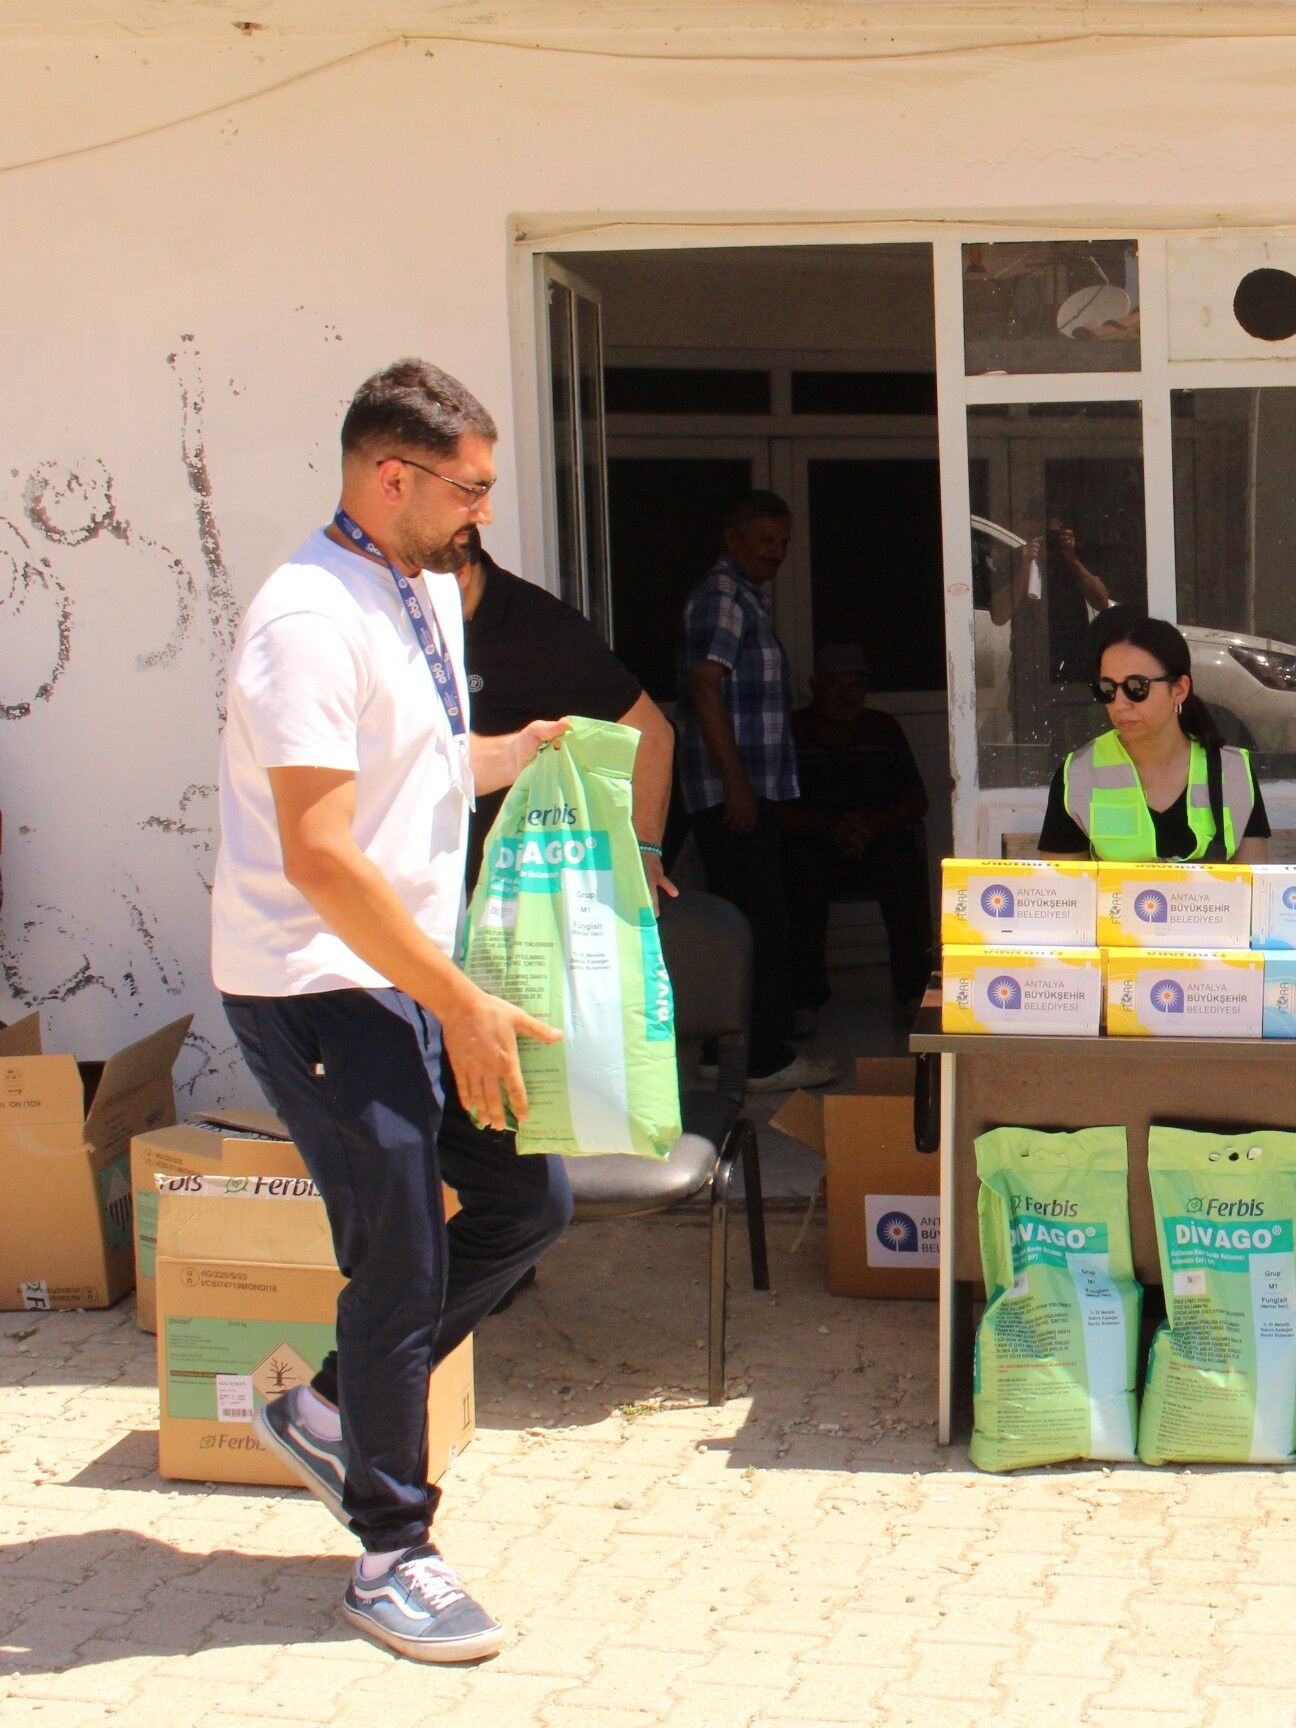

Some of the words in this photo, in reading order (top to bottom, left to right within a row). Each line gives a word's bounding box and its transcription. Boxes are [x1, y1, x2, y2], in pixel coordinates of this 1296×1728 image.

[1017, 888, 1057, 896] ANTALYA
[1170, 893, 1210, 901] ANTALYA
[1017, 898, 1078, 909] BÜYÜKŞEHİR
[1170, 903, 1231, 914] BÜYÜKŞEHİR
[1017, 910, 1071, 919] BELEDİYESİ
[1170, 915, 1223, 924] BELEDİYESİ
[1024, 980, 1065, 988] ANTALYA
[1186, 984, 1227, 992] ANTALYA
[1024, 990, 1086, 1001] BÜYÜKŞEHİR
[1186, 993, 1248, 1004] BÜYÜKŞEHİR
[1024, 1002, 1079, 1011] BELEDİYESİ
[1186, 1005, 1241, 1015] BELEDİYESİ
[254, 1176, 322, 1197] Ferbi
[1025, 1196, 1079, 1217] Ferbis
[1206, 1198, 1265, 1217] Ferbis
[1264, 1270, 1281, 1278] Grup
[219, 1434, 267, 1451] Ferbi
